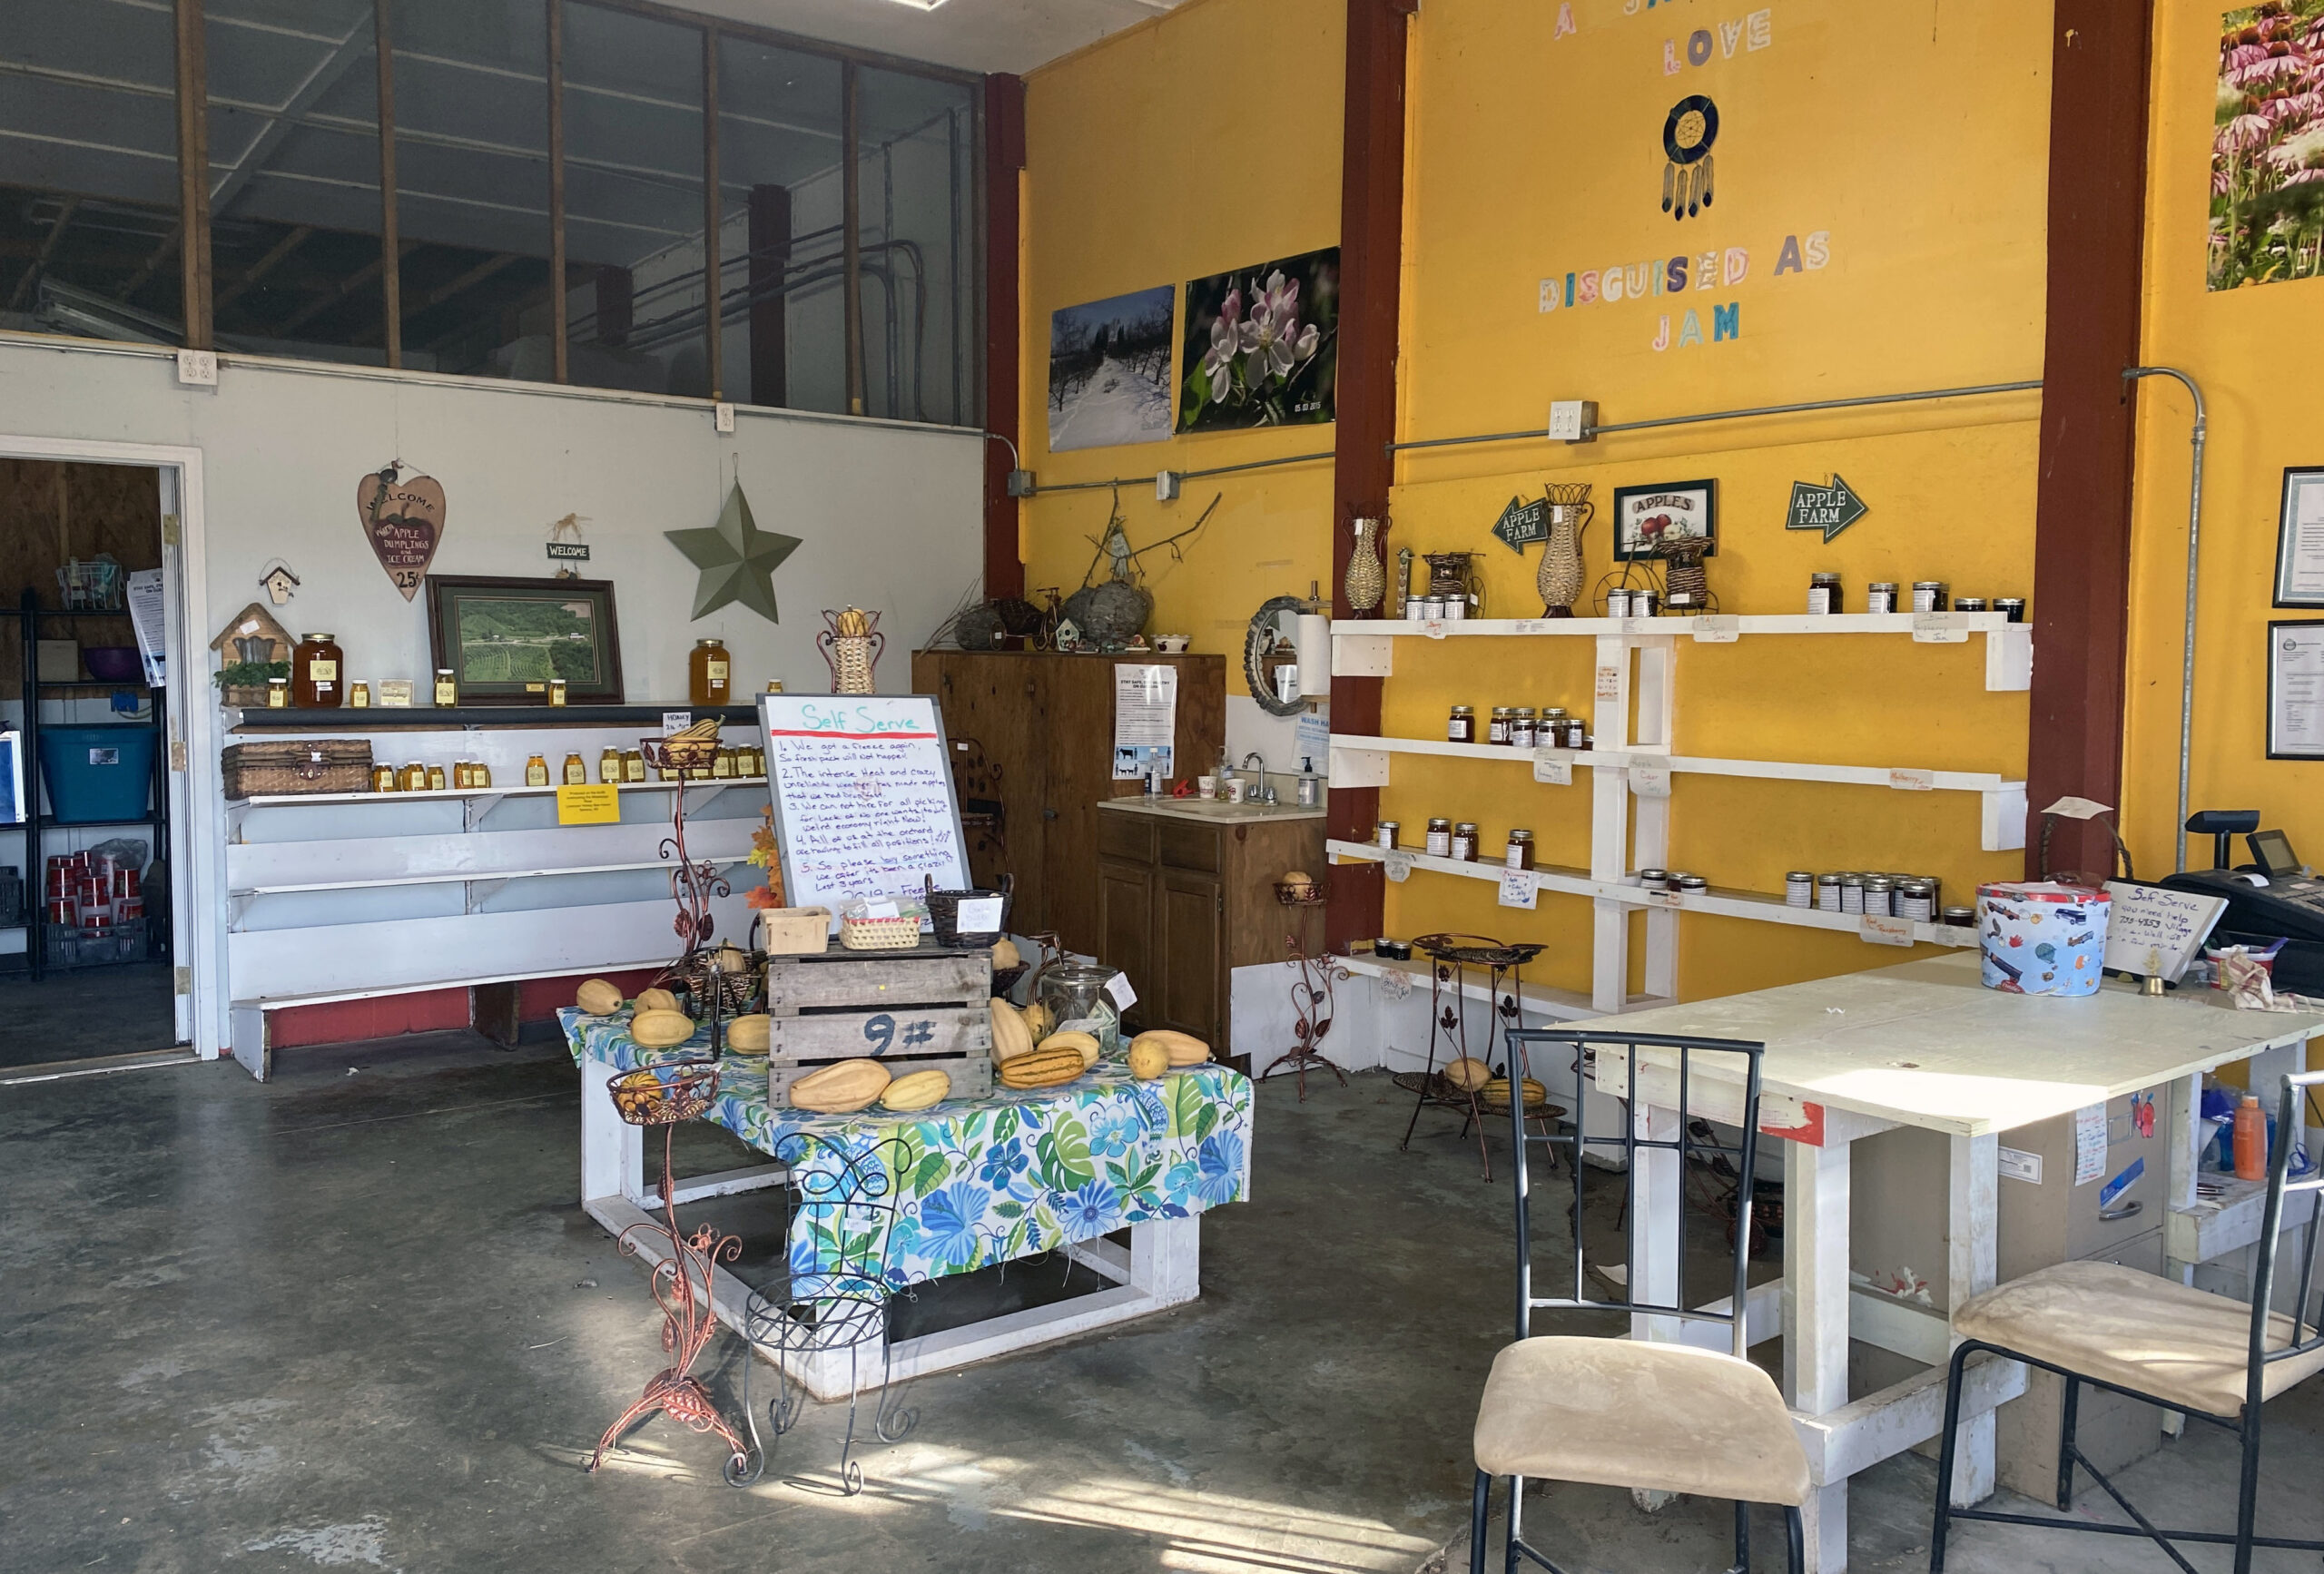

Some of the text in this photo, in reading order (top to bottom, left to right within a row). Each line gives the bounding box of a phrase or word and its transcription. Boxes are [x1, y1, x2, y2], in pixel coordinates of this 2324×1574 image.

[1553, 3, 1577, 41] A
[1663, 8, 1771, 77] LOVE
[1539, 231, 1830, 313] DISGUISED AS
[1652, 301, 1739, 352] JAM
[1635, 495, 1692, 515] APPLES
[1796, 490, 1846, 519] APPLE
[1502, 507, 1540, 529] APPLE
[1797, 506, 1840, 524] FARM
[394, 528, 419, 539] APPLE
[1505, 522, 1537, 542] FARM
[384, 539, 429, 550] DUMPLINGS
[549, 545, 587, 556] WELCOME
[387, 555, 425, 565] ICE CREAM
[801, 704, 921, 733] Self Serve
[790, 740, 813, 751] We
[821, 743, 836, 754] got
[779, 753, 793, 762] So
[792, 766, 815, 778] The
[890, 767, 907, 776] and
[801, 802, 818, 811] We
[809, 834, 829, 844] All
[816, 861, 832, 871] So
[840, 859, 876, 871] please
[838, 880, 847, 888] 3
[2158, 893, 2200, 911] Serve
